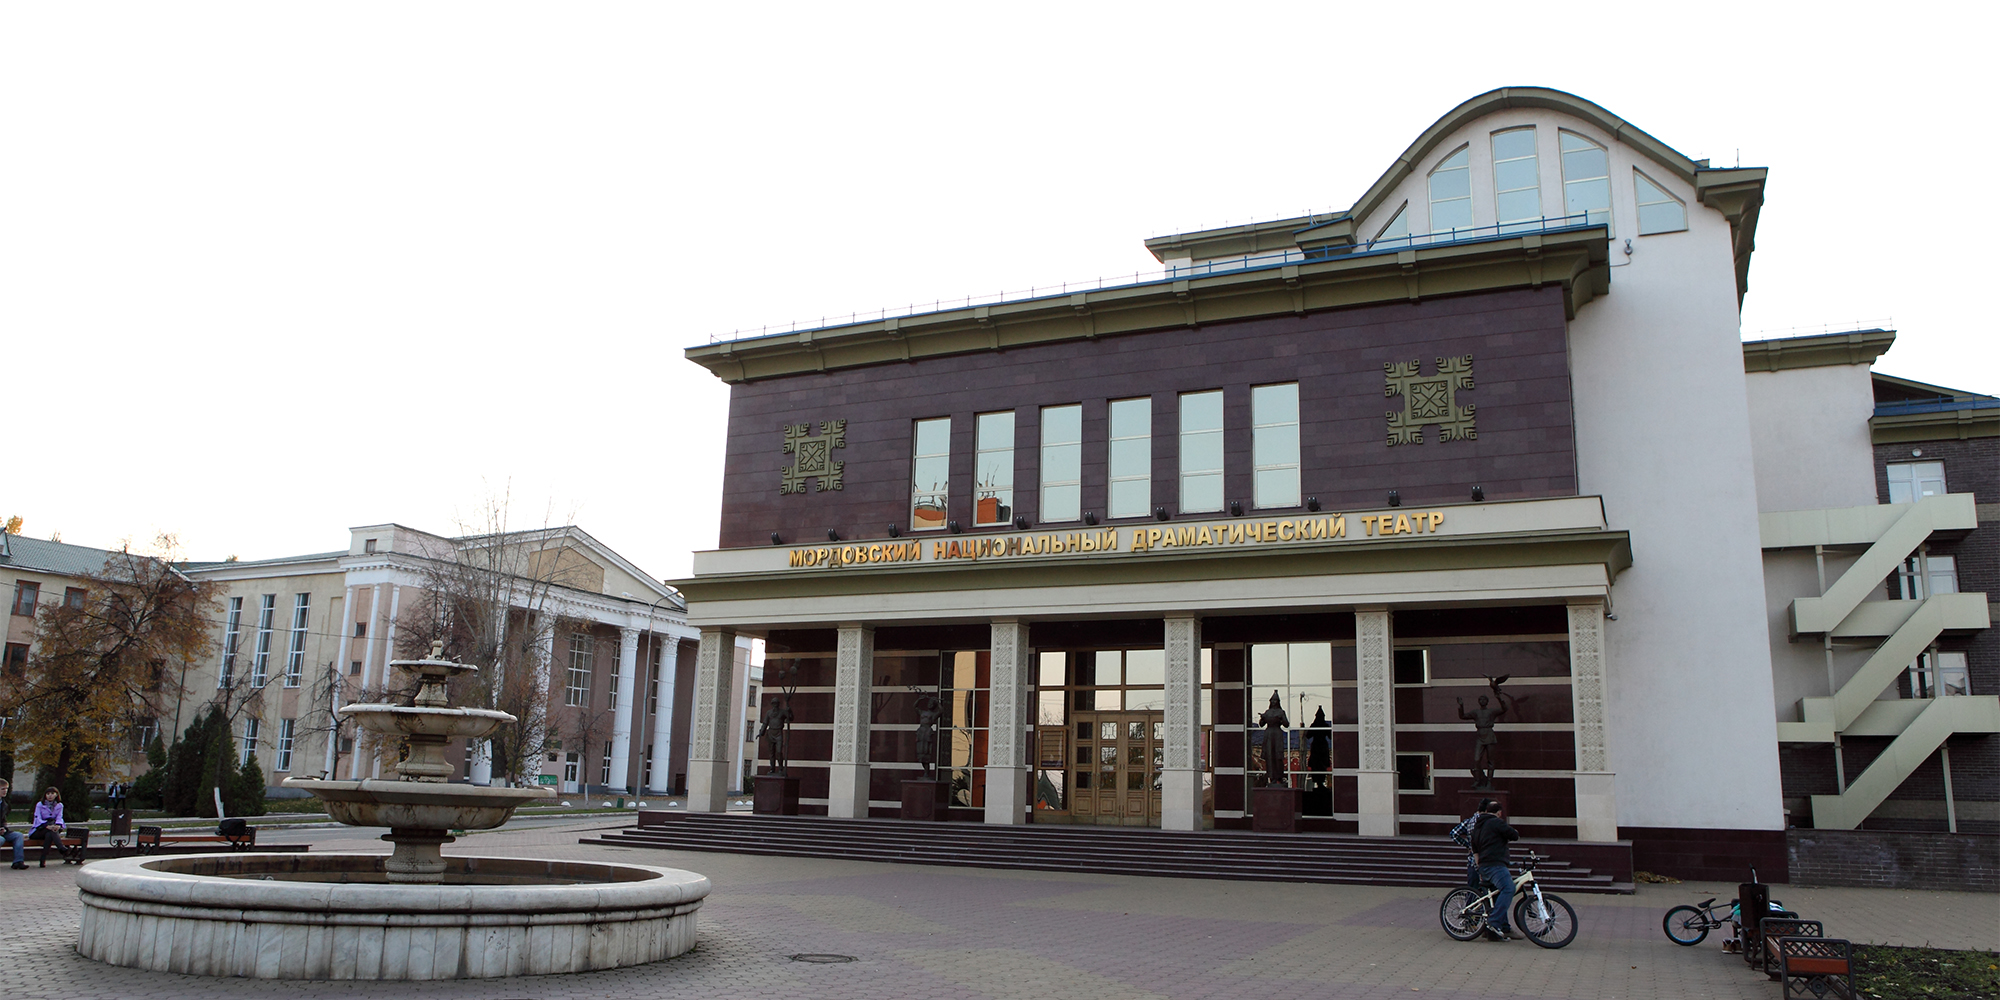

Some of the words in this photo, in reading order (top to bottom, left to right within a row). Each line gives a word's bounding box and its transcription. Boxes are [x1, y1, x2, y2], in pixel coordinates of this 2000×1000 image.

[789, 538, 922, 569] МОРДОВСКИЙ
[933, 527, 1118, 562] НАЦИОНАЛЬНЫЙ
[1130, 512, 1347, 552] ДРАМАТИЧЕСКИЙ
[1361, 511, 1445, 536] ТЕАТР
